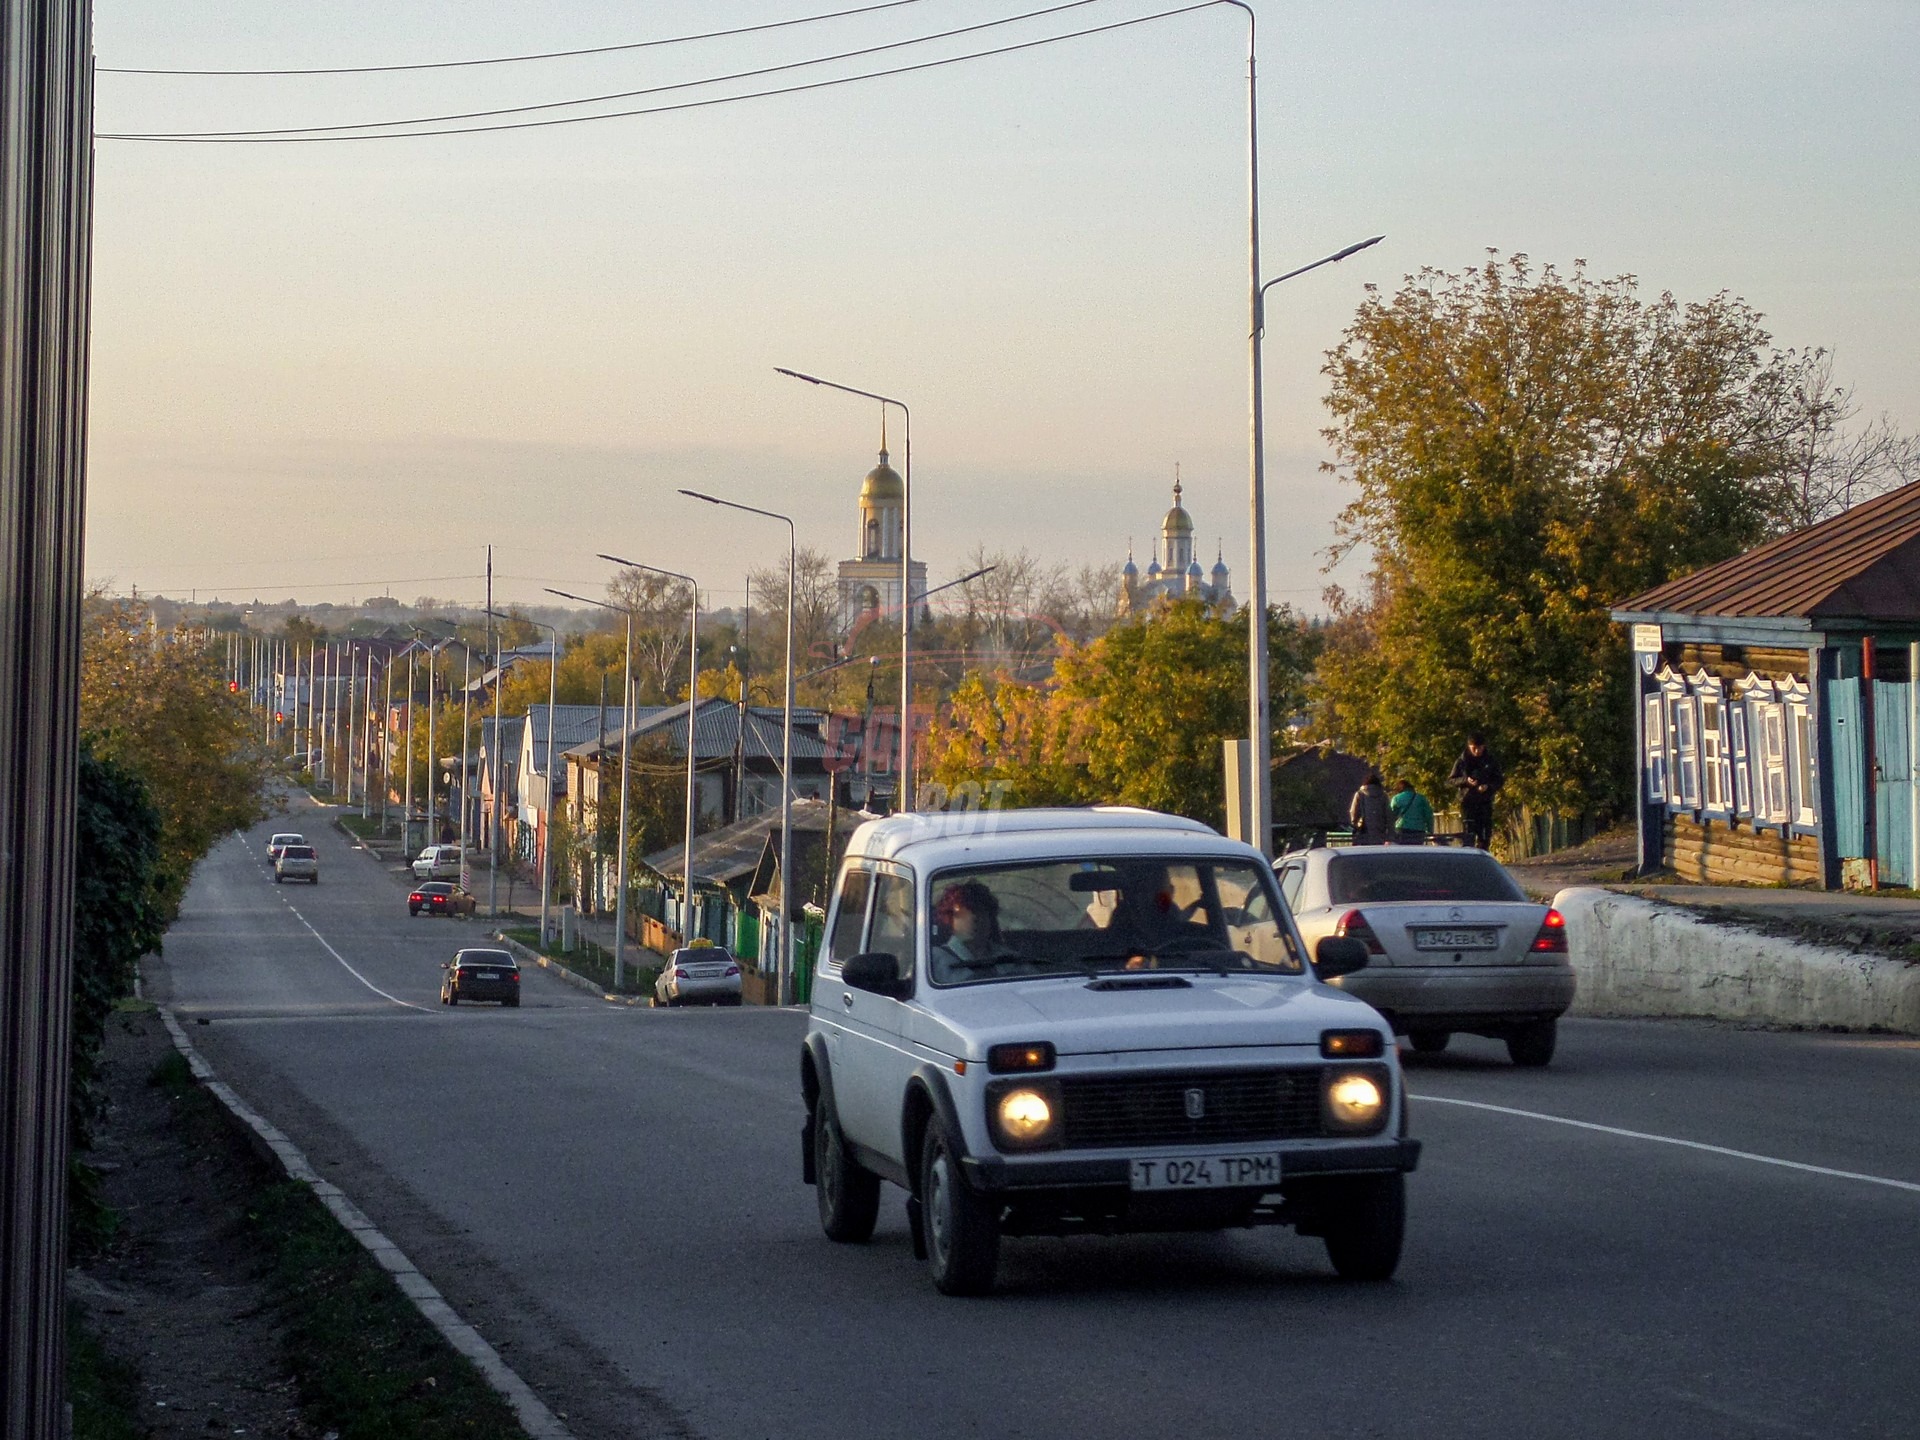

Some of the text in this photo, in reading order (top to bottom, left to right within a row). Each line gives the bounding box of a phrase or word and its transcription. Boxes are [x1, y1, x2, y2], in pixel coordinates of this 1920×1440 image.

[1139, 1156, 1275, 1186] T 024 TPM
